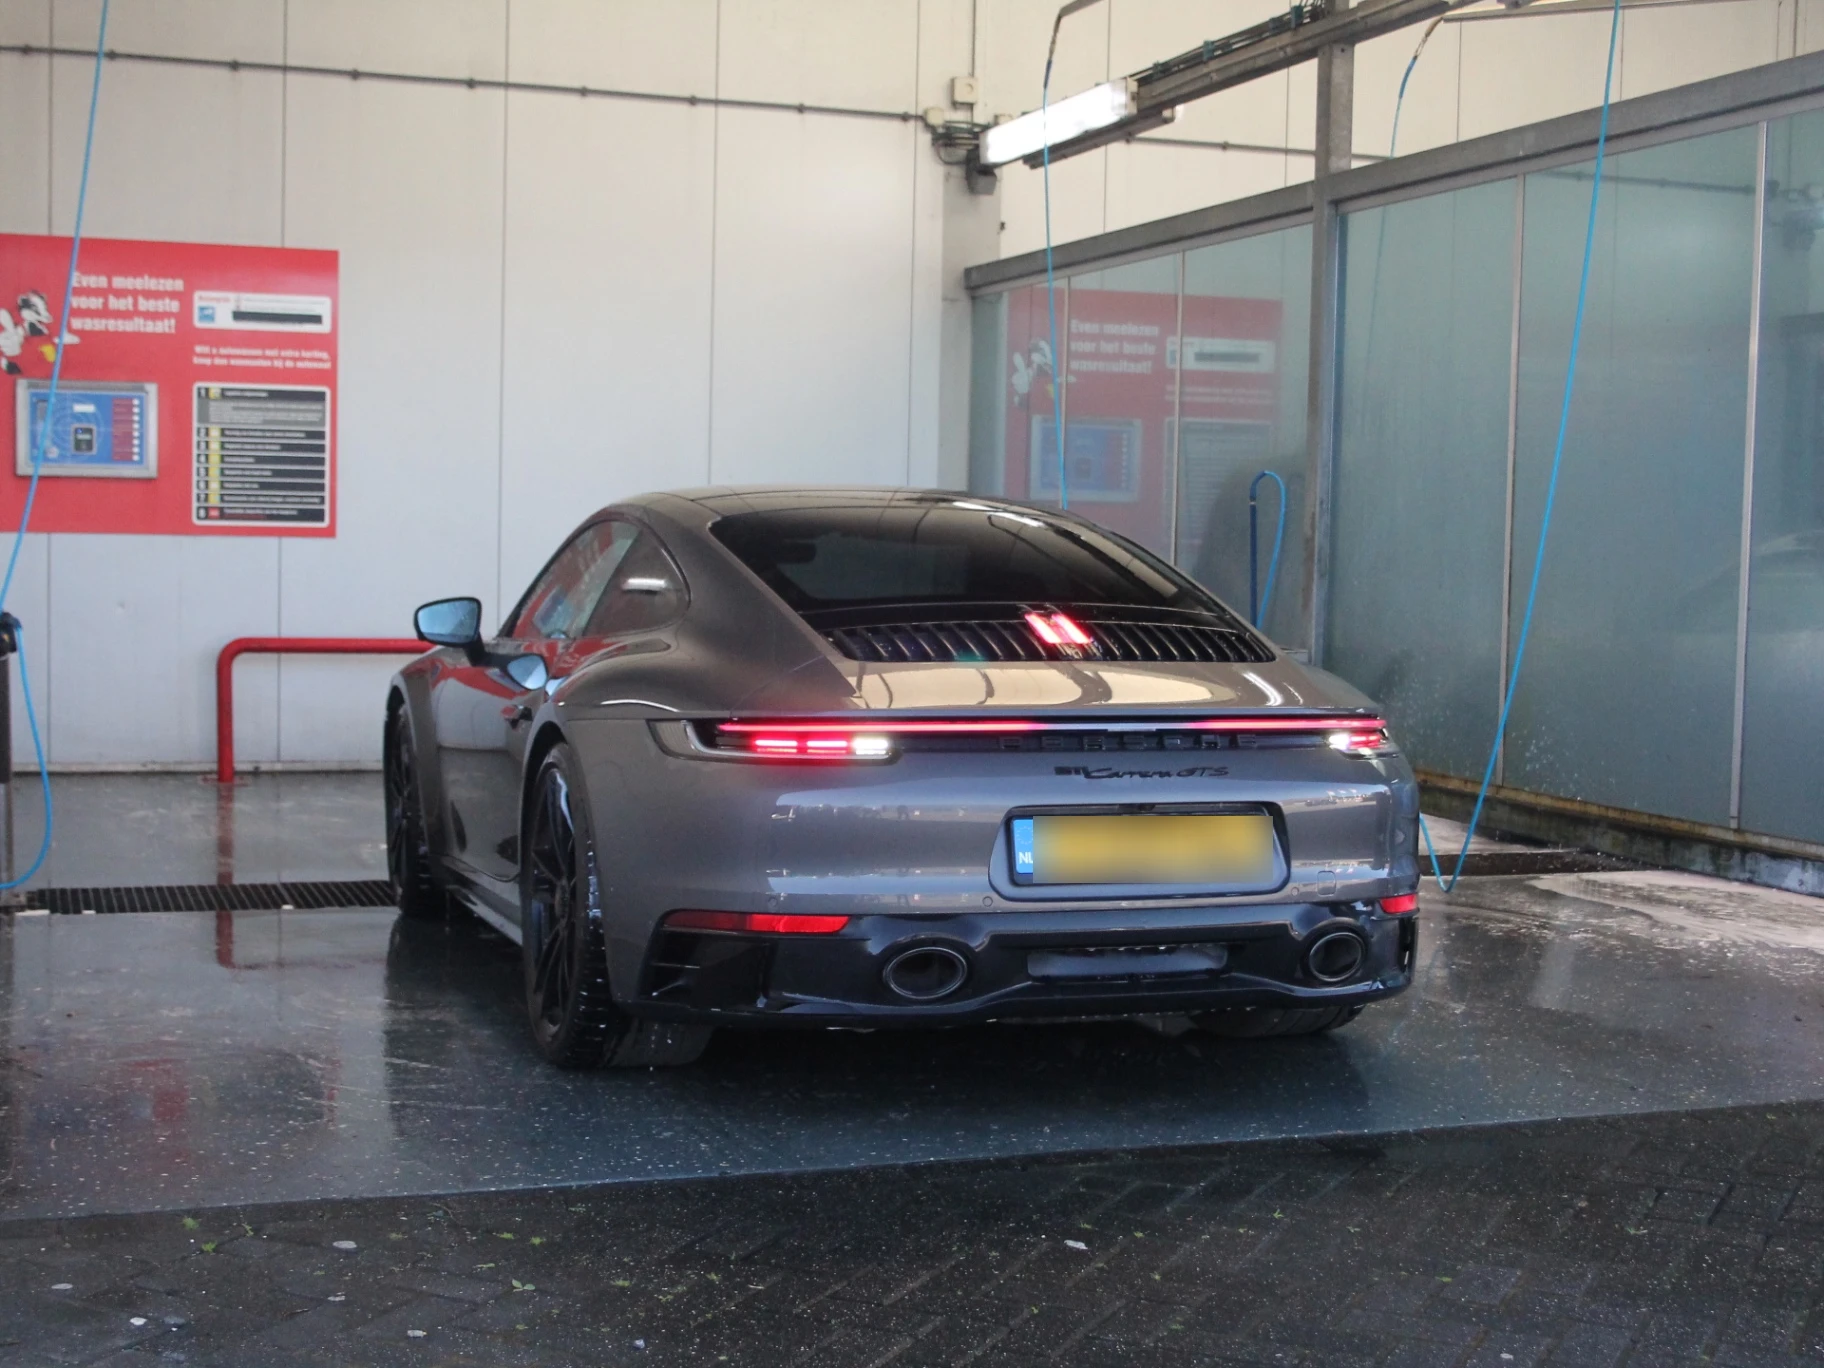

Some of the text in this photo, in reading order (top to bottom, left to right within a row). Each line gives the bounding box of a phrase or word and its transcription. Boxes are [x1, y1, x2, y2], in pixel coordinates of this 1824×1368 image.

[72, 271, 184, 292] Even meelezen
[71, 295, 105, 309] voor
[108, 294, 133, 311] het
[138, 295, 180, 313] beste
[70, 316, 176, 334] wasresultaat!
[1084, 766, 1173, 780] Carrera
[1176, 766, 1229, 778] GTS
[1018, 851, 1033, 864] NL
